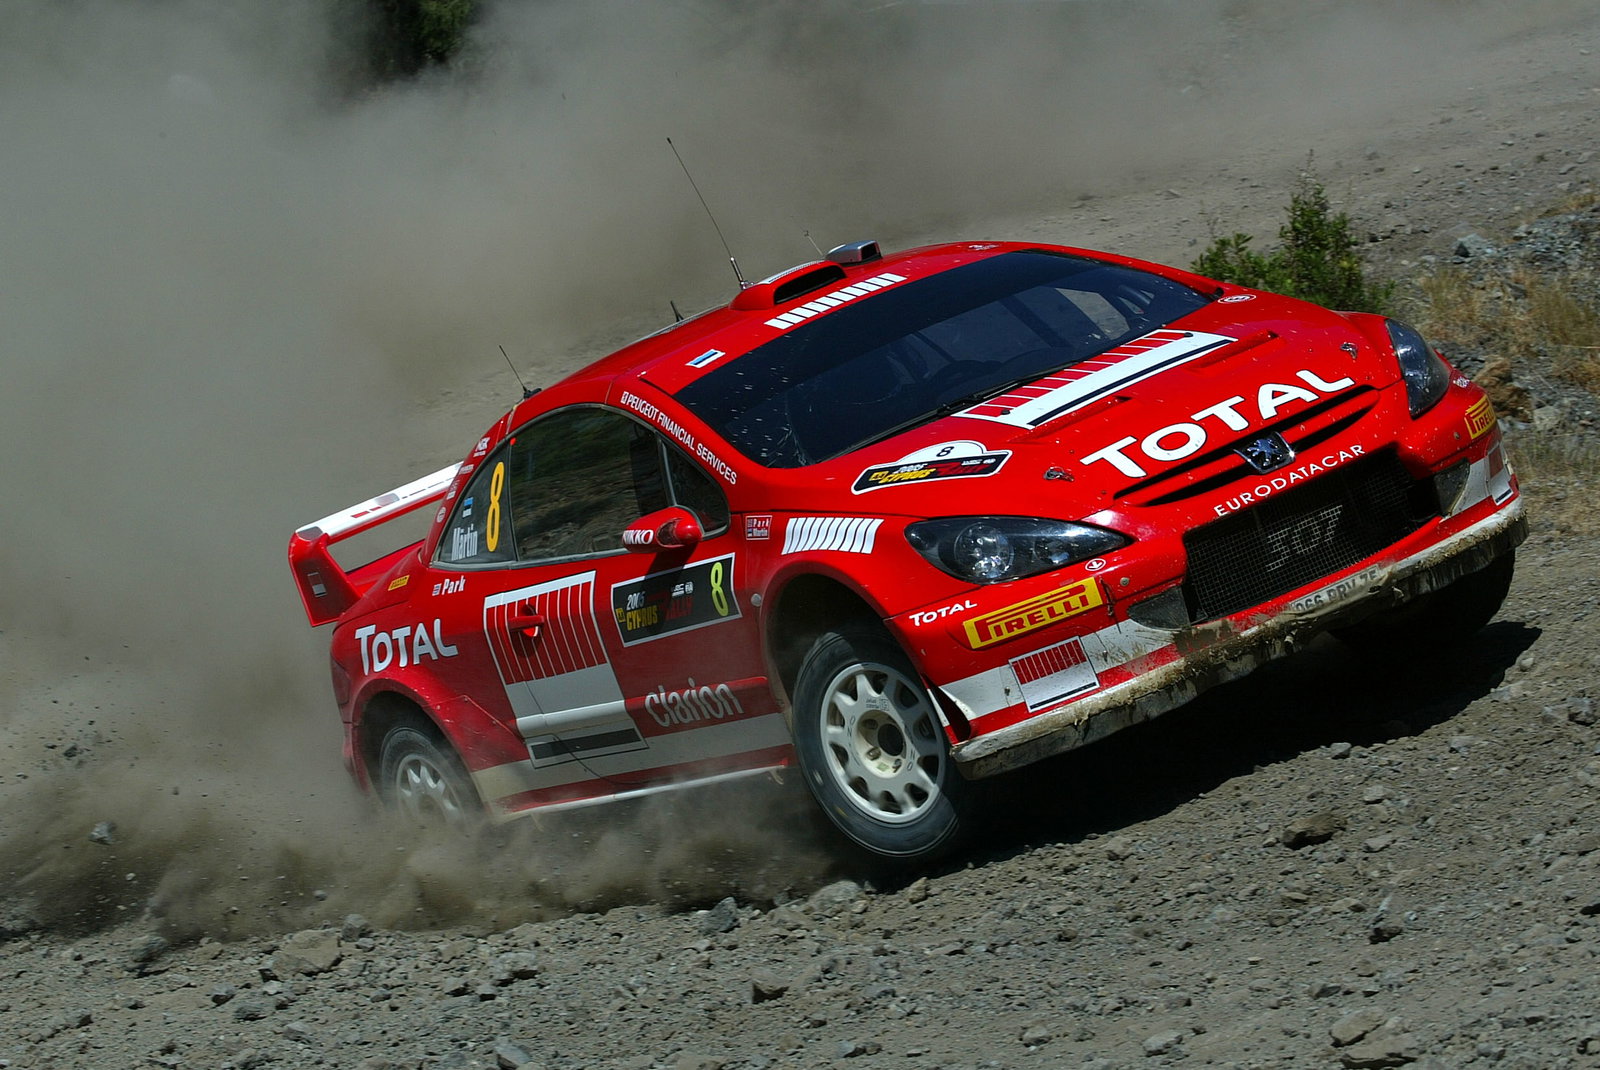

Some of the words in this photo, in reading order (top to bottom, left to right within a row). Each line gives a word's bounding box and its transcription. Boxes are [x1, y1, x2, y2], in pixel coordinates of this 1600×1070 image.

[627, 393, 659, 420] PEUGEOT
[657, 411, 695, 451] FINANCIAL
[696, 443, 737, 485] SERVICES
[936, 446, 954, 457] 8
[1079, 369, 1355, 478] TOTAL
[486, 461, 505, 552] 8
[1213, 444, 1366, 518] EURODATACAR
[622, 529, 654, 545] NIKKO
[1265, 504, 1343, 573] 307
[441, 574, 466, 596] Park
[710, 561, 729, 617] 8
[908, 600, 978, 626] TOTAL
[974, 584, 1090, 643] PIRELLI
[626, 605, 658, 631] CYPRUS
[354, 618, 459, 676] TOTAL
[644, 677, 745, 727] clarion
